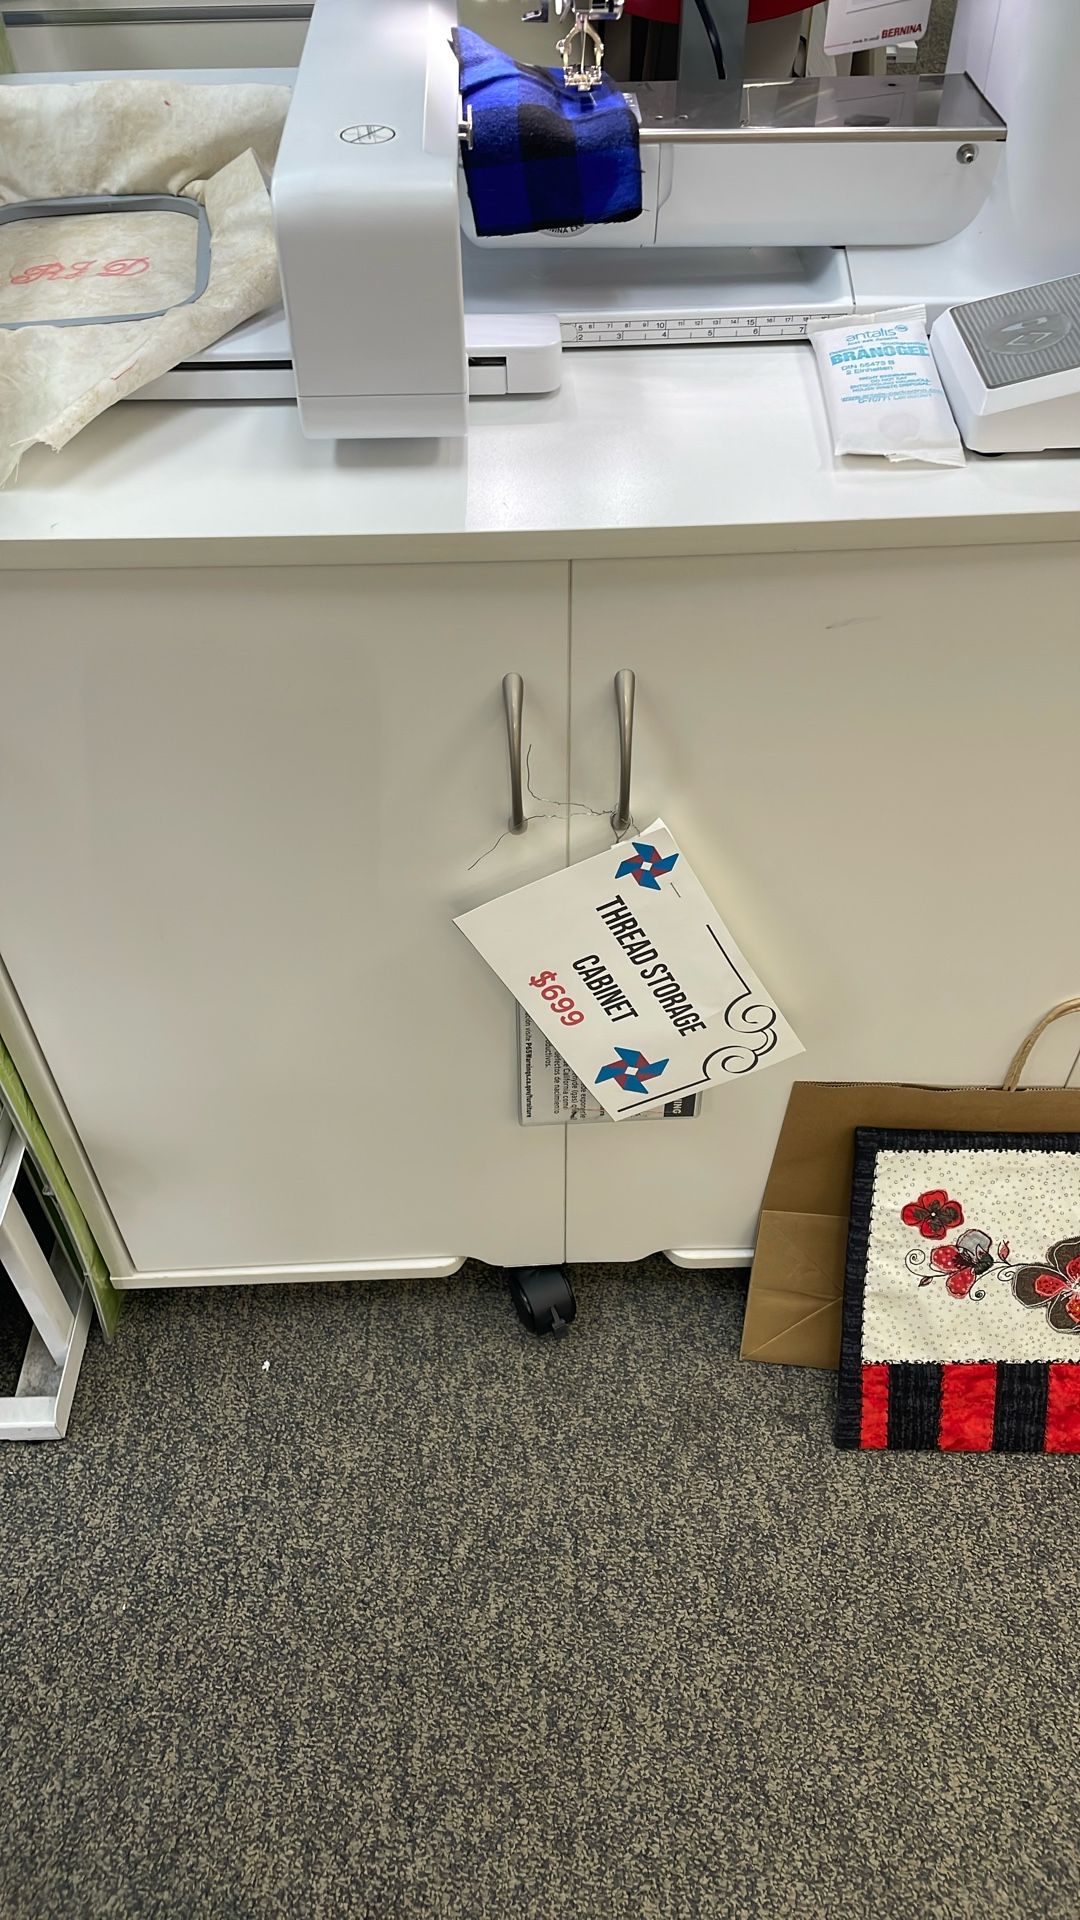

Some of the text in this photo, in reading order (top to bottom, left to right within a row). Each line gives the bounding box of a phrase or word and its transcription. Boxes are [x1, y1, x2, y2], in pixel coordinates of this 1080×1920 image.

[881, 24, 922, 39] BERNINA
[846, 327, 896, 342] antalis
[596, 895, 707, 1037] THREAD STORAGE
[572, 954, 639, 1022] CABINET
[528, 970, 585, 1026] $699
[554, 1076, 561, 1084] de
[570, 1089, 579, 1103] (gas)
